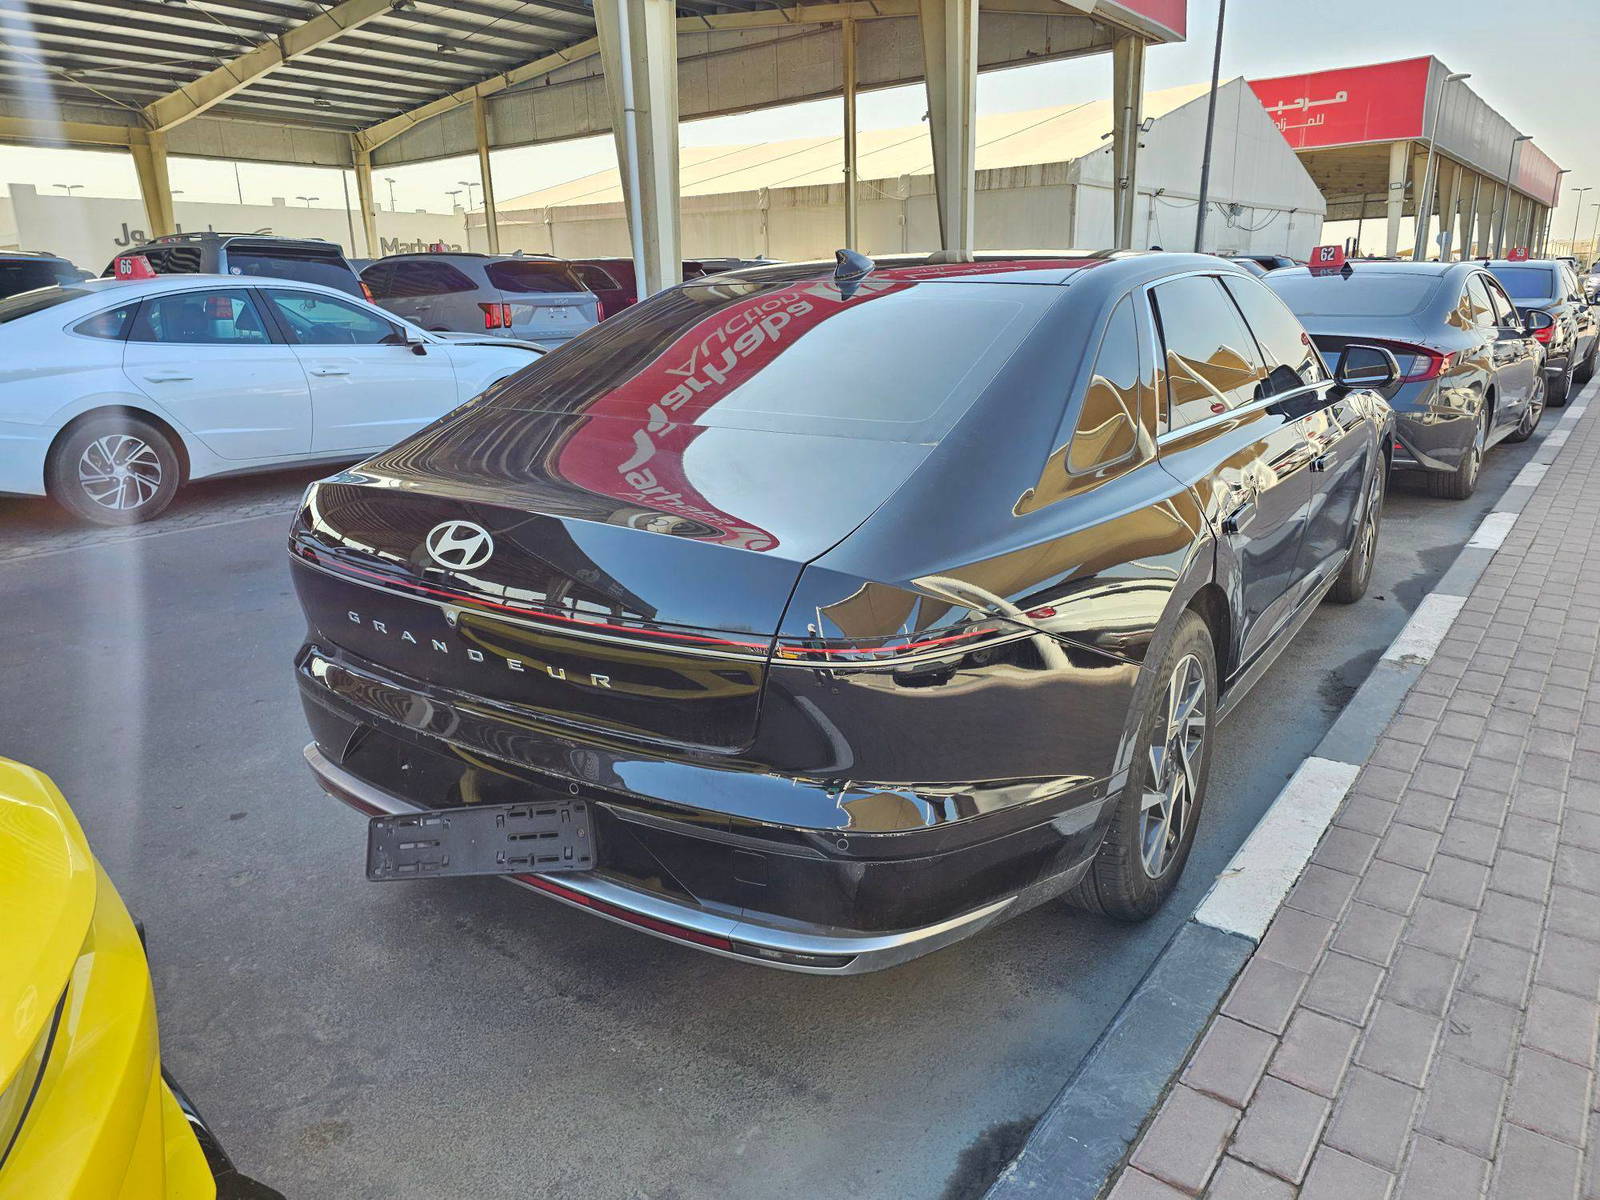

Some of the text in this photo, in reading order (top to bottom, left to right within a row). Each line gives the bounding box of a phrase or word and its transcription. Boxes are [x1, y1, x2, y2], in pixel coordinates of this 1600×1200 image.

[1259, 90, 1348, 115] مرحب
[380, 236, 463, 256] Marhba
[1320, 247, 1335, 261] 62
[120, 258, 132, 275] 66
[347, 610, 611, 689] GRANDEUR
